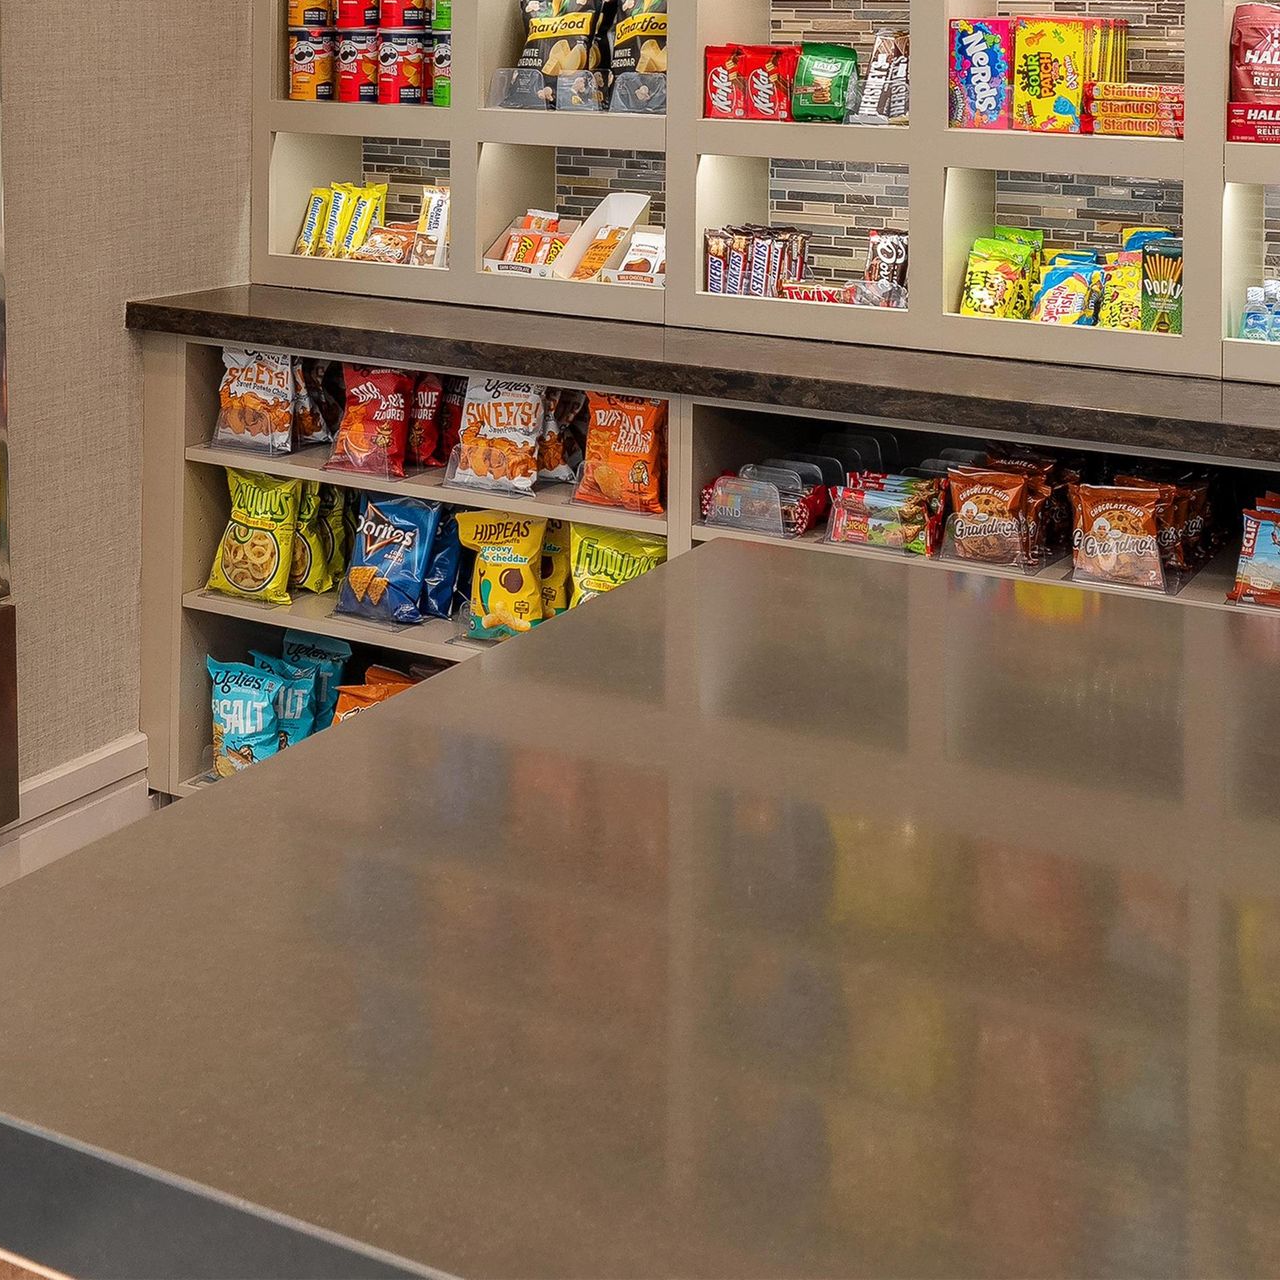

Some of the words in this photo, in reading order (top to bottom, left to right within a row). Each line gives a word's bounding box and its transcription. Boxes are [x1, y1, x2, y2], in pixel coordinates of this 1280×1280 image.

[964, 31, 994, 112] Nerds
[1027, 56, 1040, 98] SOUR
[1040, 52, 1053, 98] PATCH
[1102, 86, 1156, 99] Starburst
[308, 196, 323, 246] Butterfinger
[326, 191, 343, 245] Butterfinger
[344, 200, 367, 250] Butterfinger
[432, 199, 443, 230] CARAMEL
[784, 287, 840, 303] Twix
[1144, 278, 1183, 299] POCKY
[1061, 293, 1074, 314] Fish
[717, 506, 741, 518] KIND
[473, 522, 531, 542] HIPPEAS
[1242, 520, 1258, 547] CLIF
[480, 545, 512, 555] groovy
[489, 553, 529, 563] cheddar
[213, 670, 262, 692] Uglies
[221, 699, 269, 734] SALT
